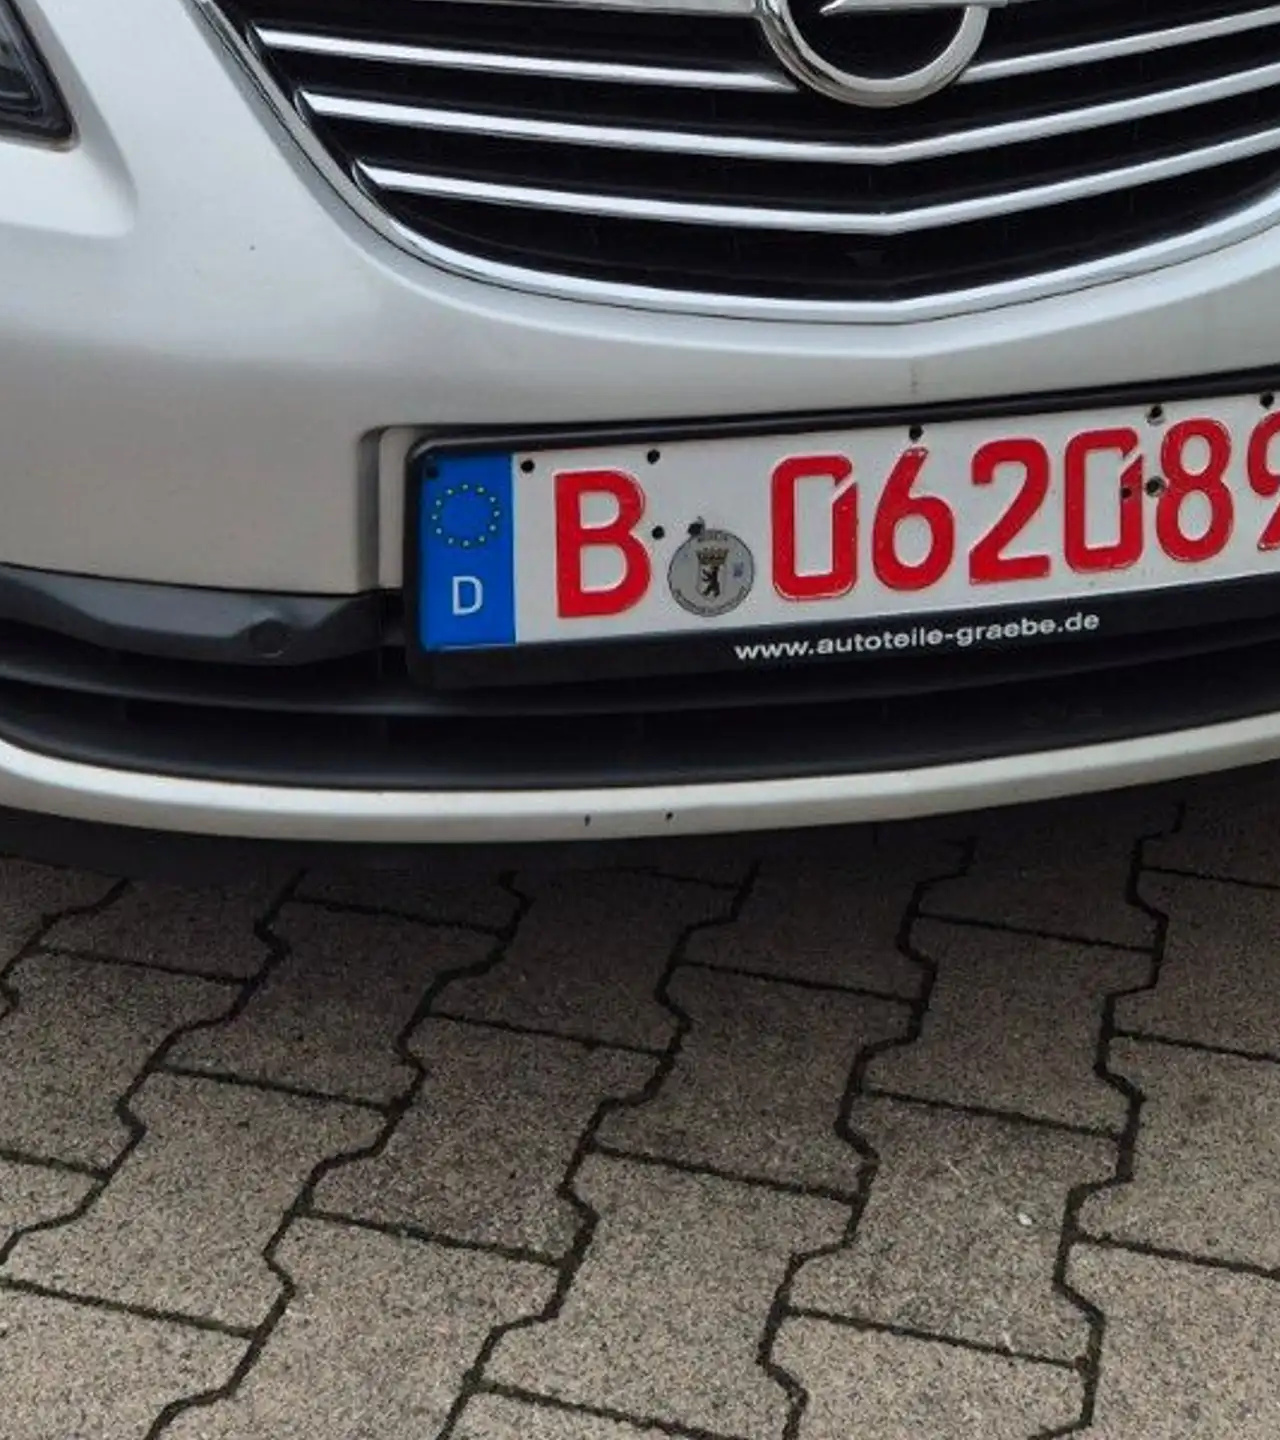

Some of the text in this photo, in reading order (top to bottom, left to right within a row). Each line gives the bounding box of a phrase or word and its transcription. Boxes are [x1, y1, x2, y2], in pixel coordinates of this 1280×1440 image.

[553, 468, 652, 619] B
[451, 575, 484, 616] D
[734, 610, 1101, 661] www.autoteile-graebe.de
